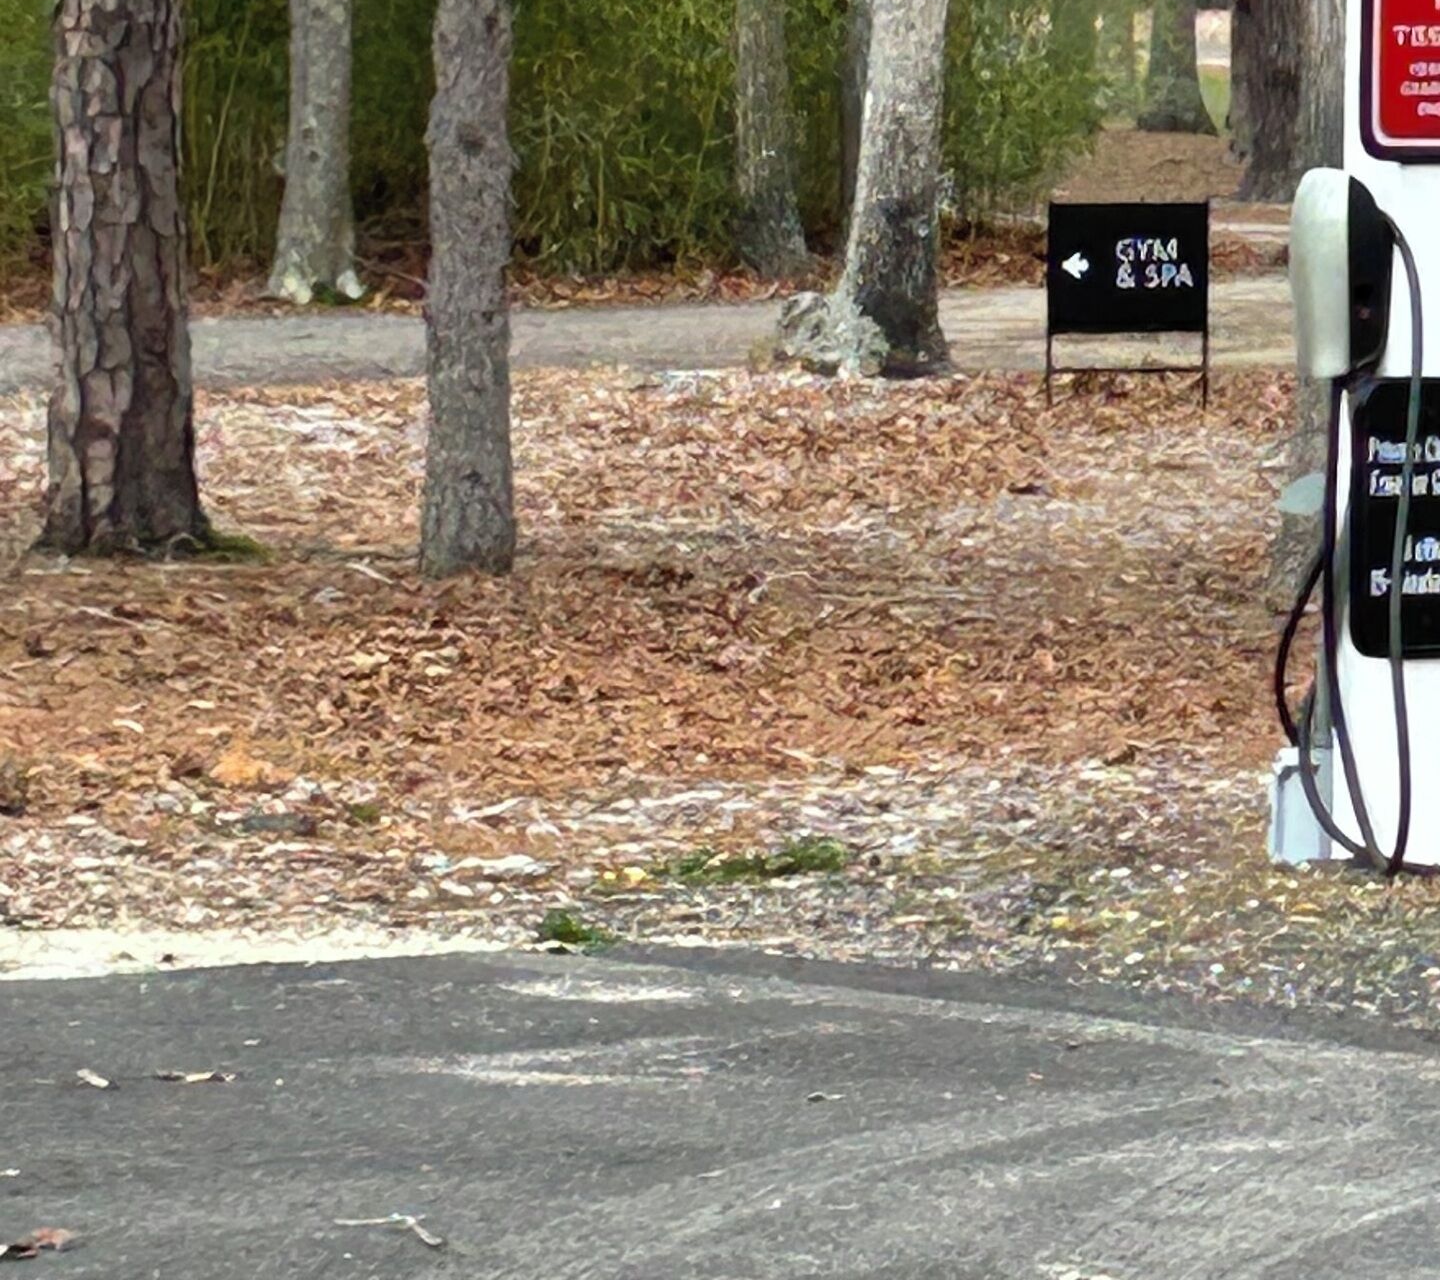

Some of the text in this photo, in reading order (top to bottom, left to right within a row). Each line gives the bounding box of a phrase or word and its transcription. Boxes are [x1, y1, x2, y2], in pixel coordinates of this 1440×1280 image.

[1116, 238, 1178, 261] GYM
[1116, 263, 1193, 288] & SPA
